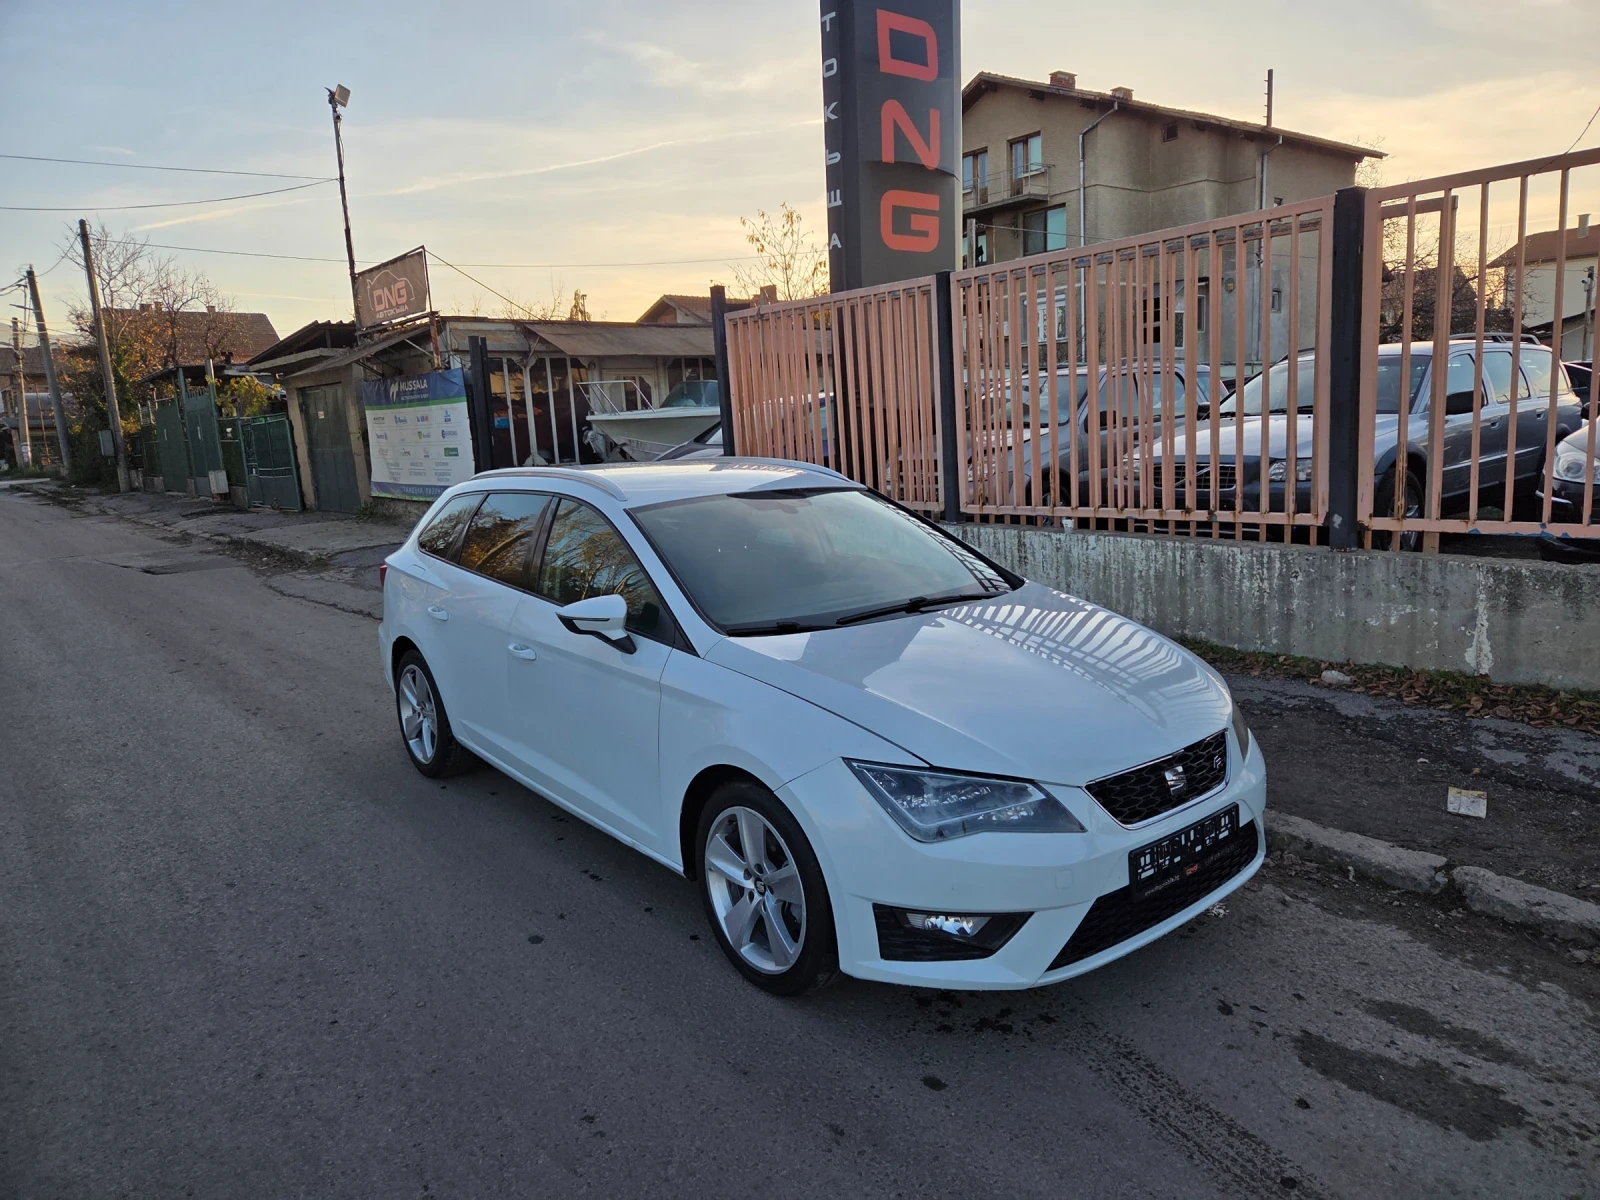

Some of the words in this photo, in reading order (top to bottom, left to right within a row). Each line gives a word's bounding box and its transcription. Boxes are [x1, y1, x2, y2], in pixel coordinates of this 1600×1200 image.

[876, 8, 941, 253] DNG
[372, 280, 407, 312] DNG
[399, 378, 428, 391] MUSSALA
